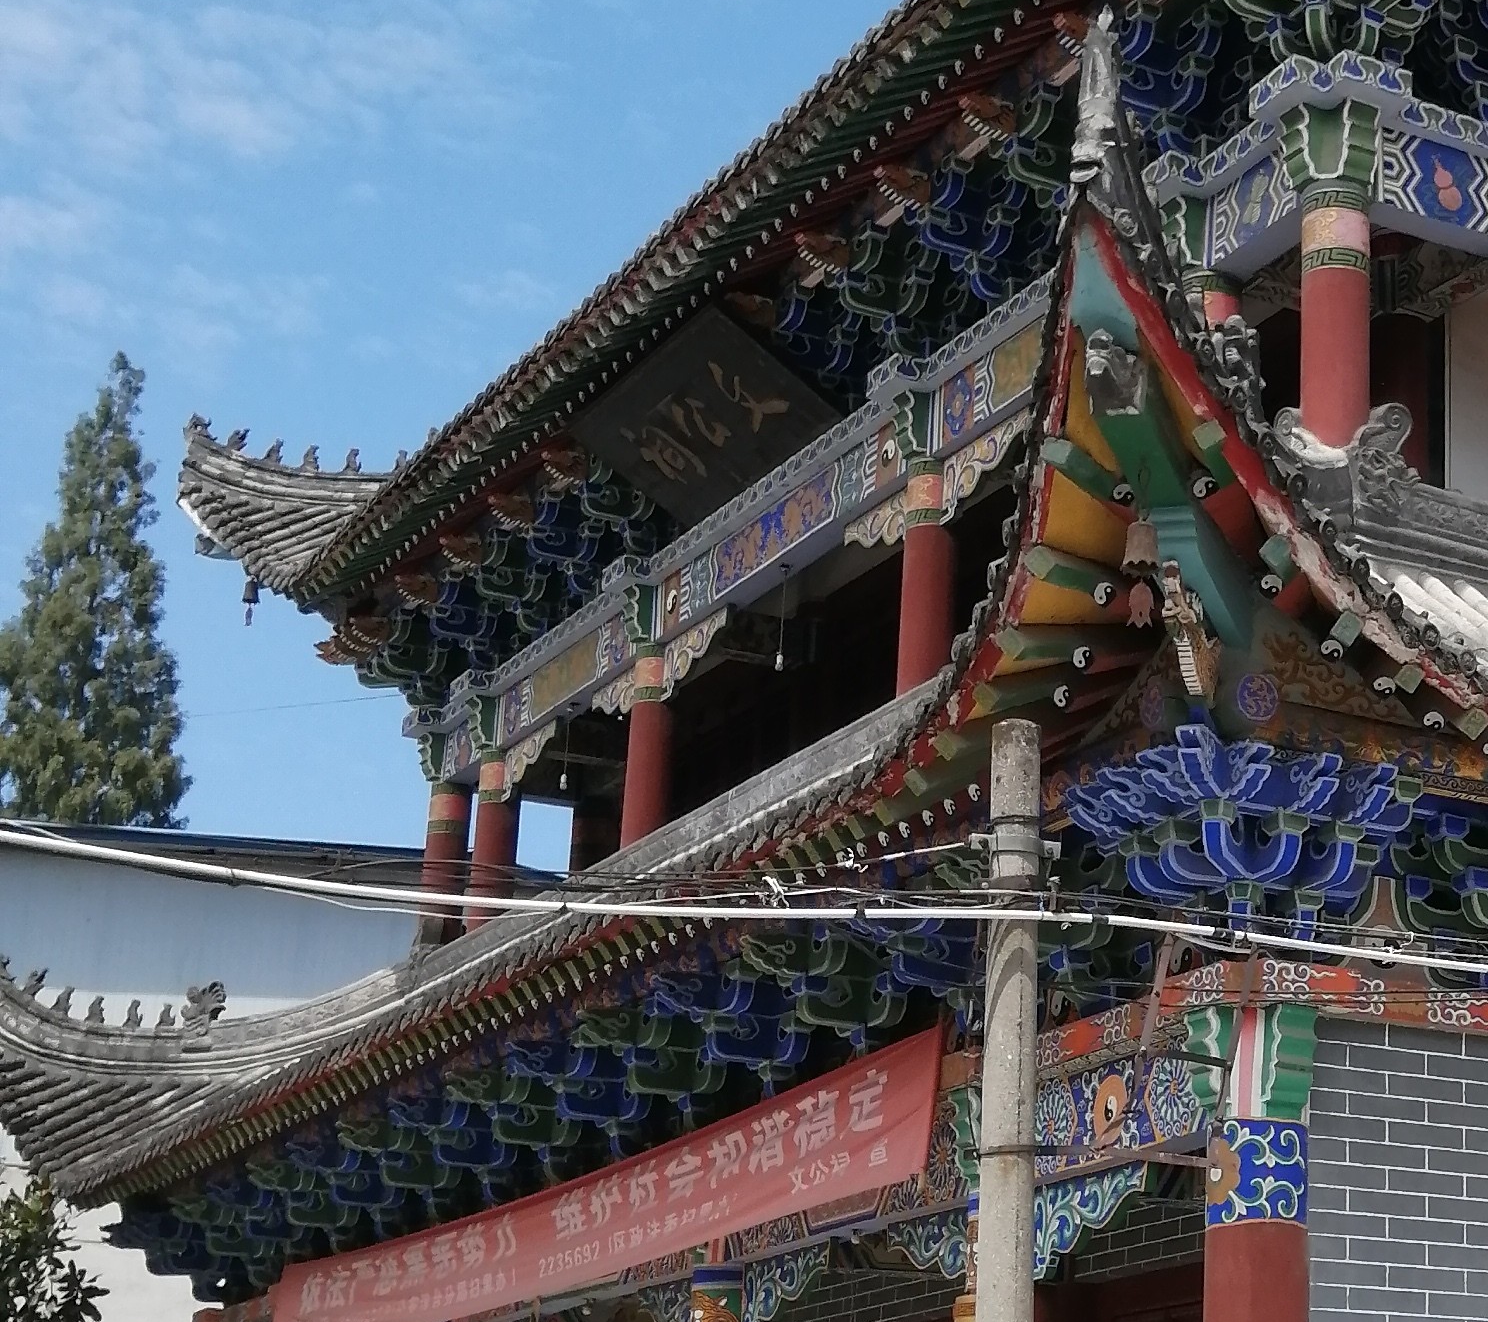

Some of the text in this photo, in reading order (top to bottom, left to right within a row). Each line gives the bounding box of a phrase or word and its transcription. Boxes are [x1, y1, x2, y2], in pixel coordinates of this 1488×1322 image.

[550, 1068, 889, 1241] 维护社会和谐稳定
